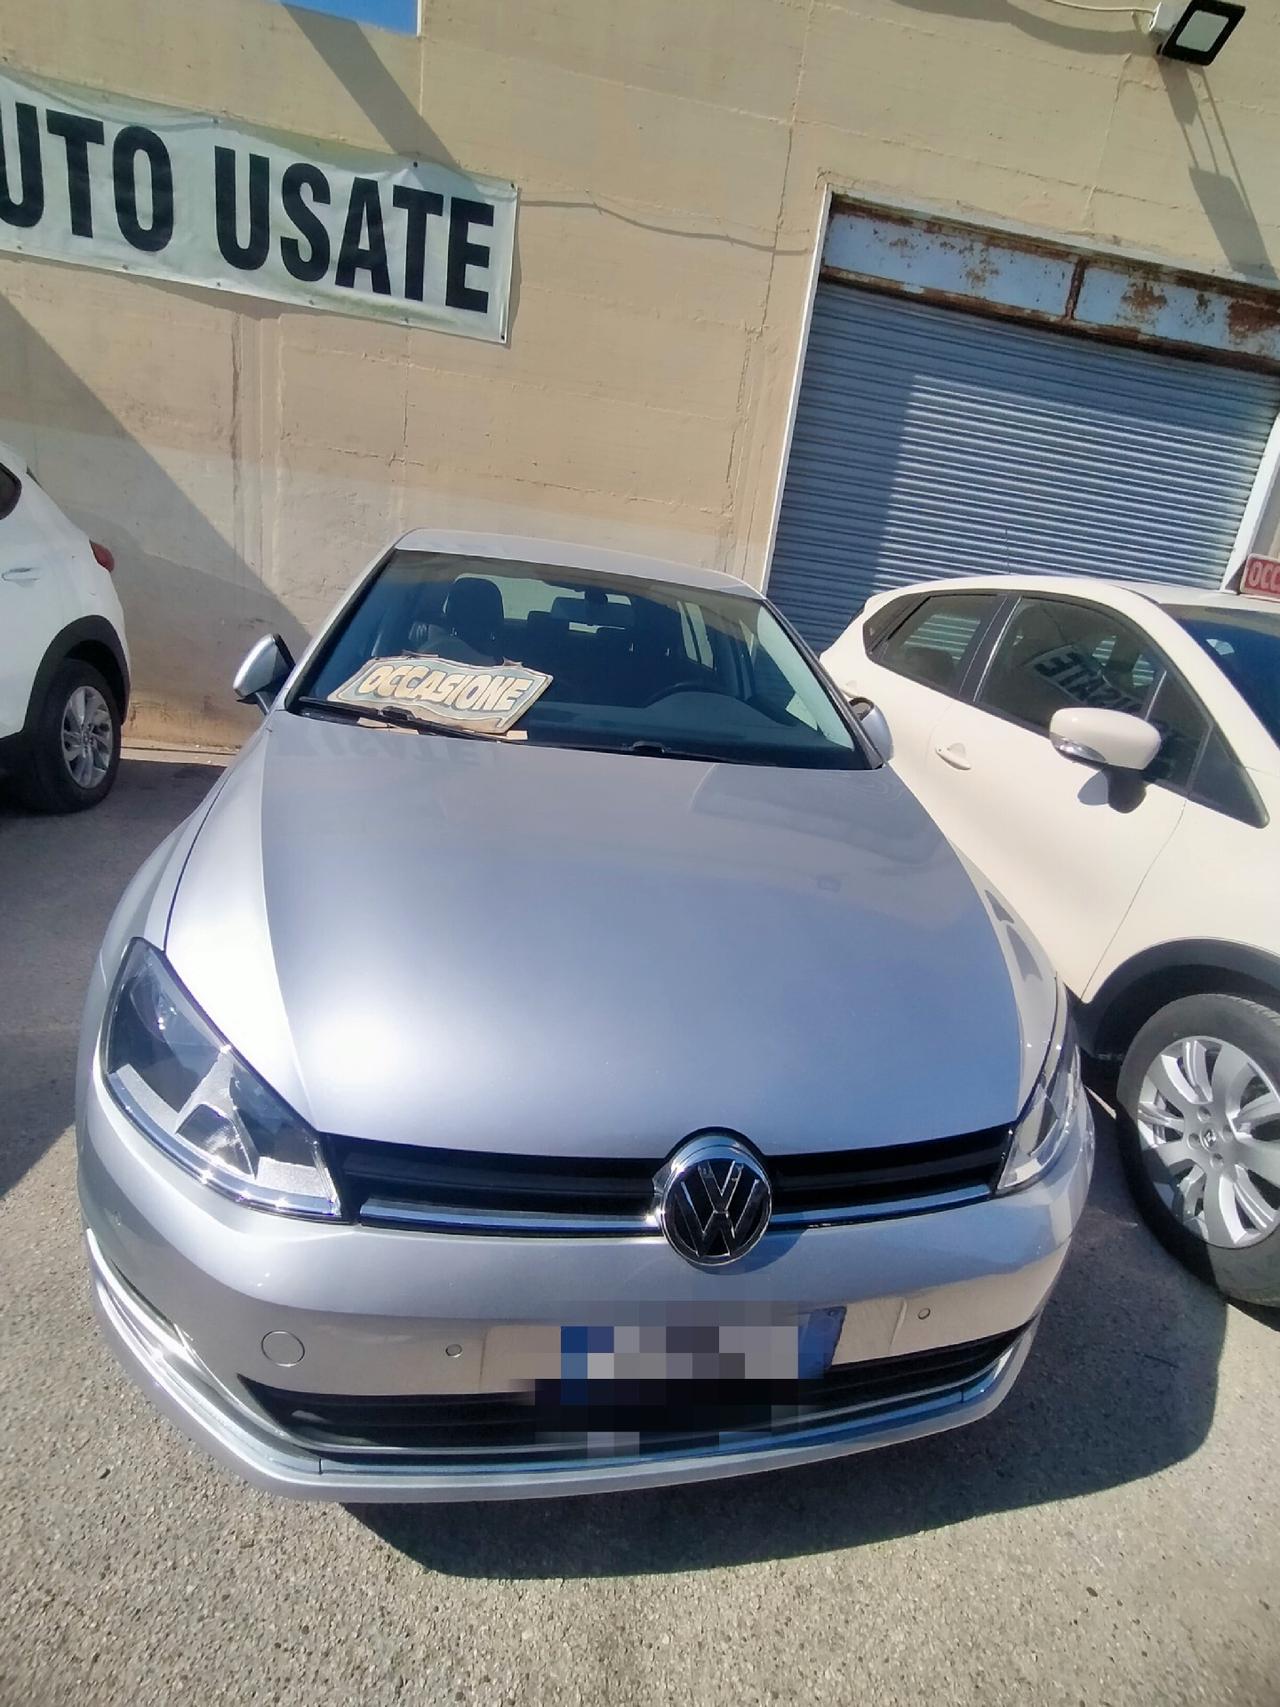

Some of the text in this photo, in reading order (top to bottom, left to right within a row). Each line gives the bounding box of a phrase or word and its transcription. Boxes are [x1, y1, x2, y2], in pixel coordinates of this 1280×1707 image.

[0, 101, 494, 313] UTO USATE
[355, 665, 535, 712] OCCASIONE
